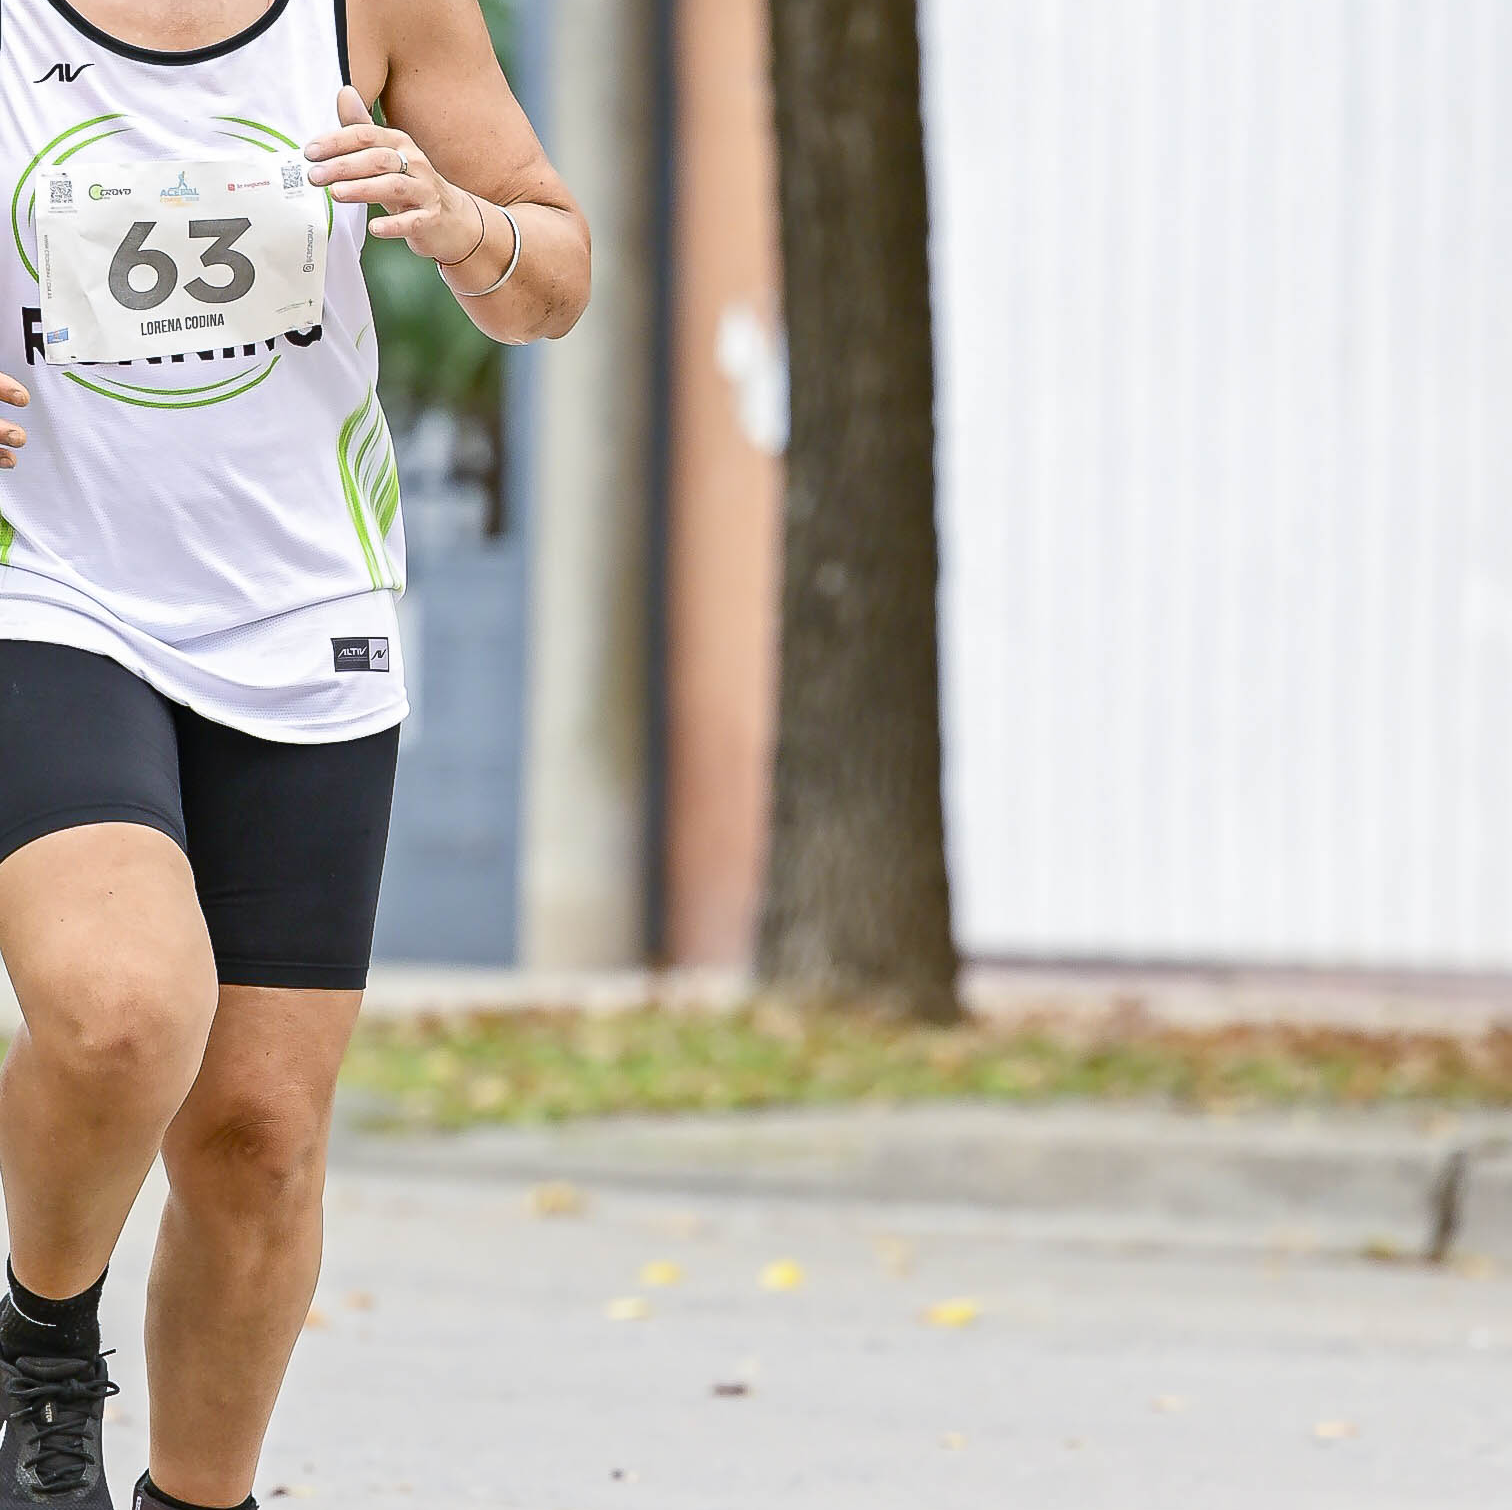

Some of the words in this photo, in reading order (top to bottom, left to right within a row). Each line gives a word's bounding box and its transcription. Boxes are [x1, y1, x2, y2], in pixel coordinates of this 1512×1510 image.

[108, 218, 256, 311] 63
[140, 317, 183, 336] LORENA
[185, 313, 225, 330] CODINA
